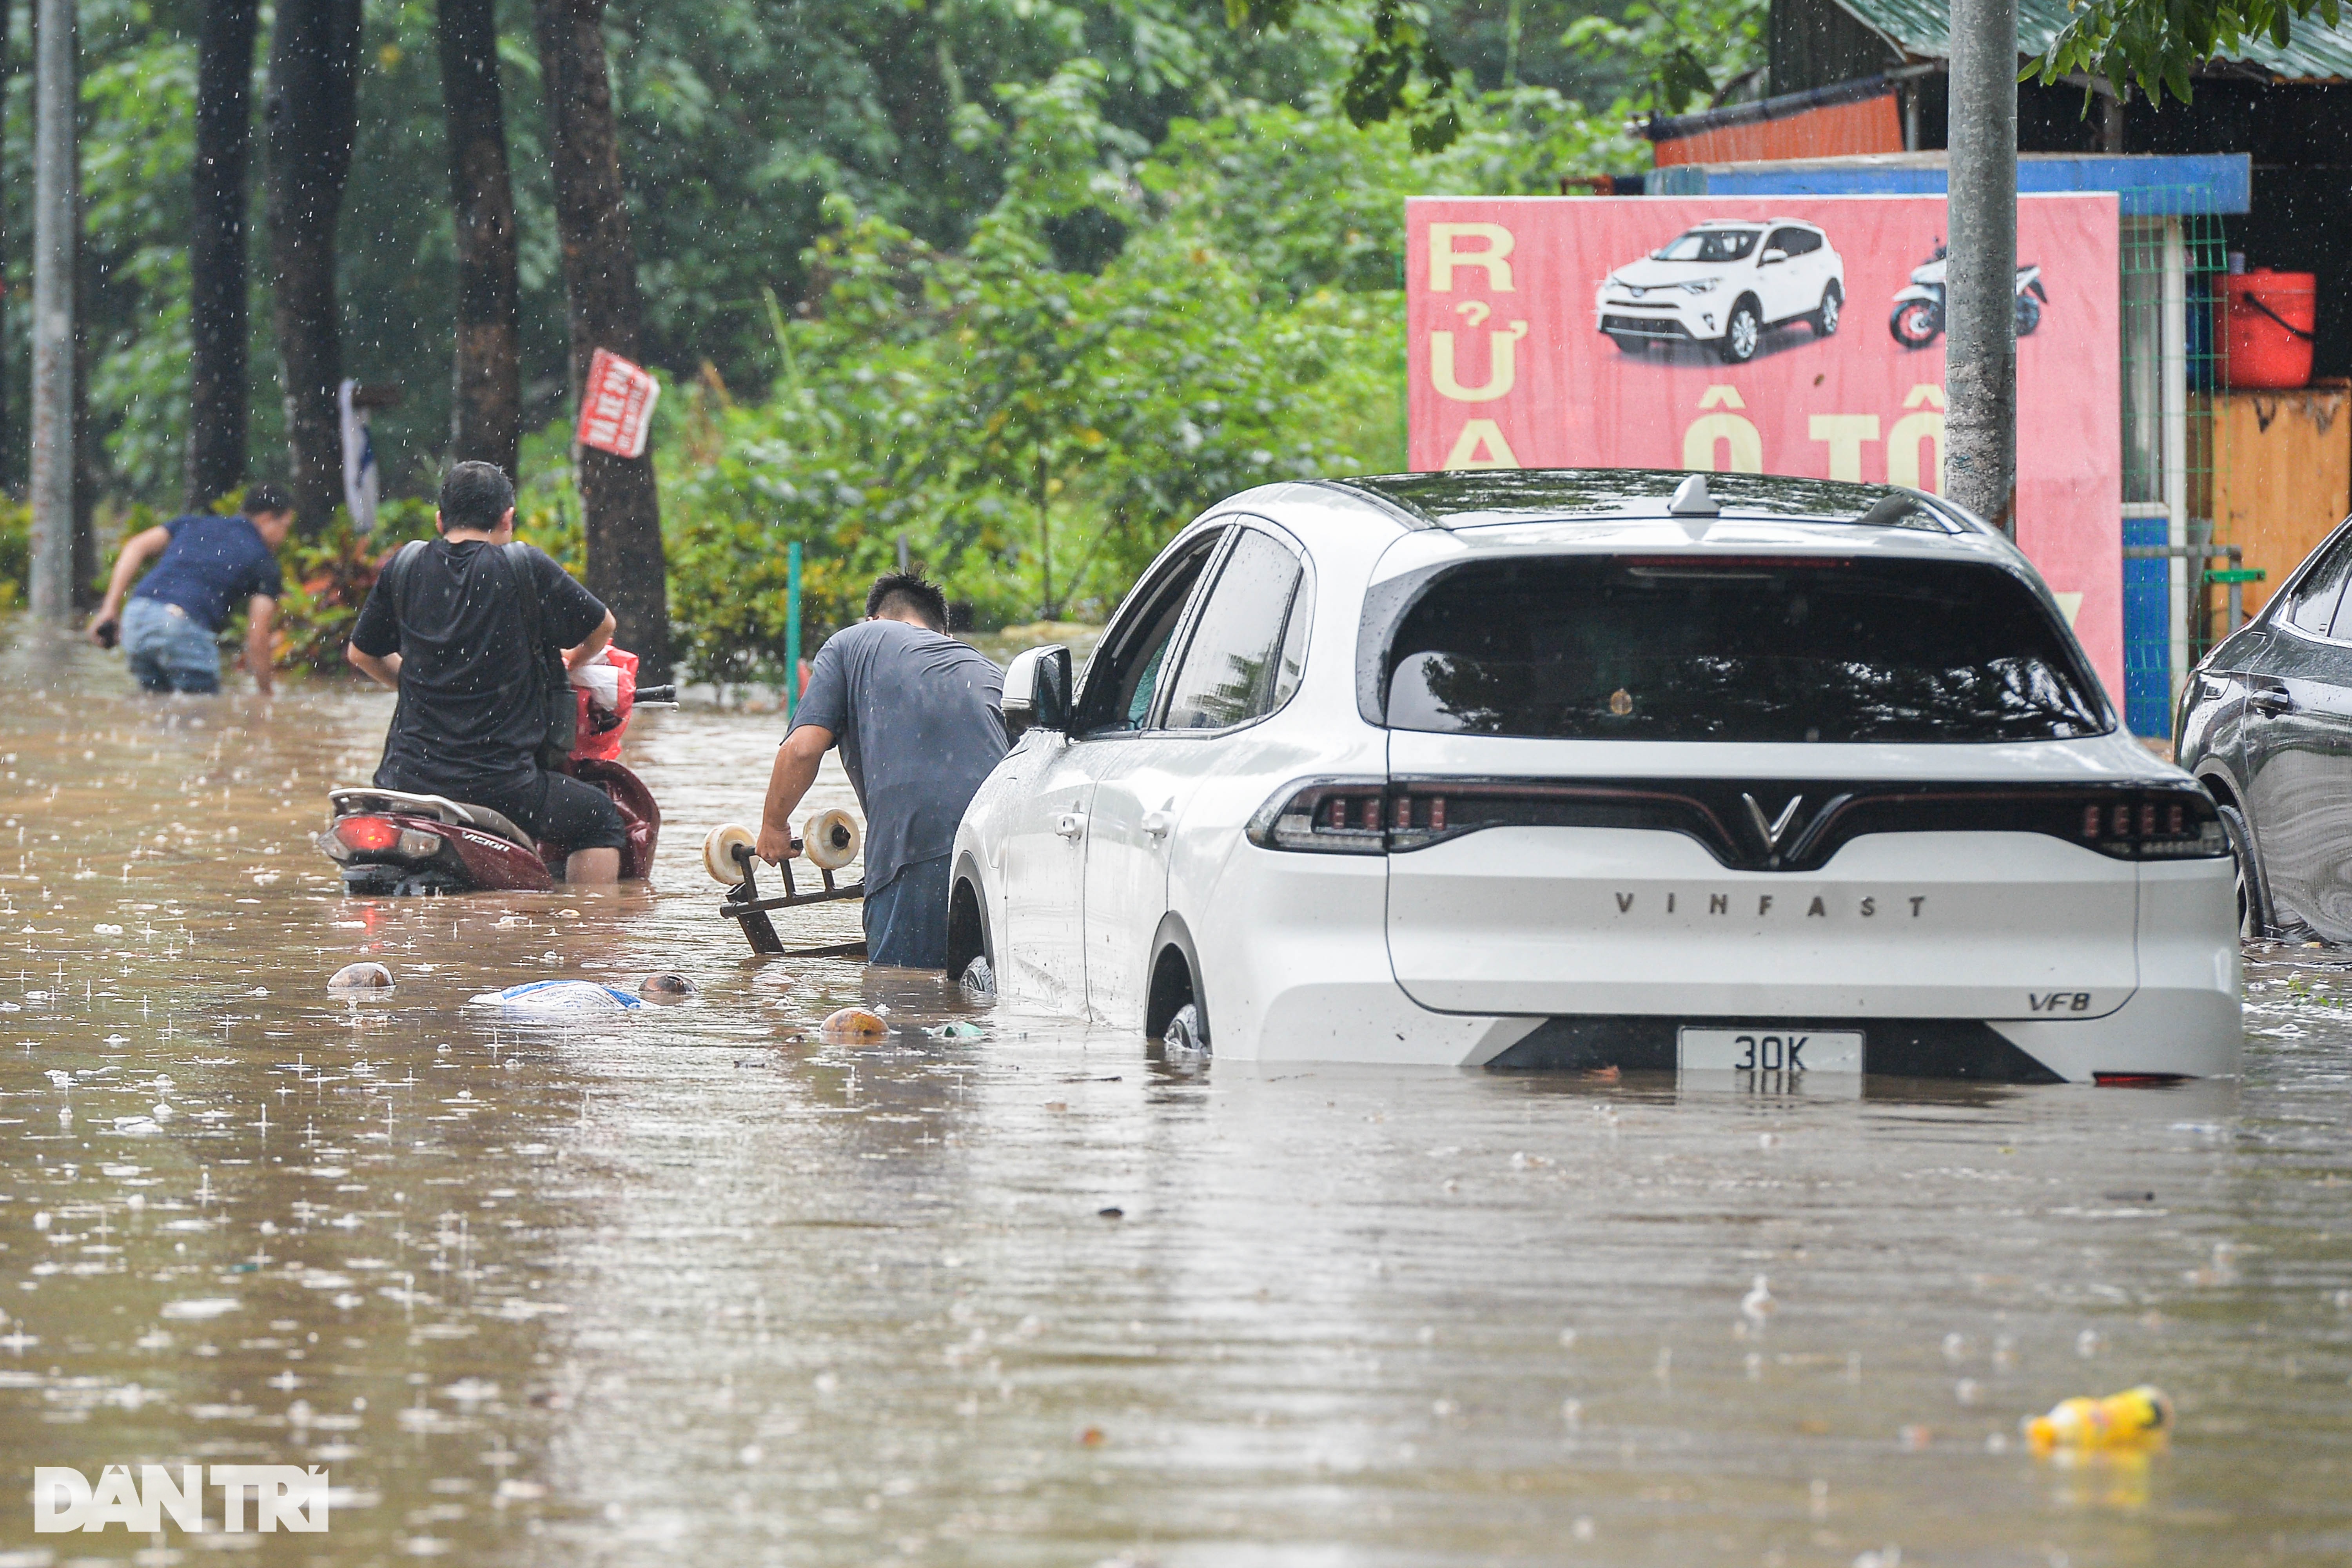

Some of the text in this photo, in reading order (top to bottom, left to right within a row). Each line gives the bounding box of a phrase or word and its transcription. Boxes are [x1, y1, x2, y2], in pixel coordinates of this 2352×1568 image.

[462, 831, 510, 852] VISION
[1616, 892, 1926, 917] VINFAST
[2029, 993, 2091, 1011] VF8
[1735, 1036, 1809, 1071] 30K
